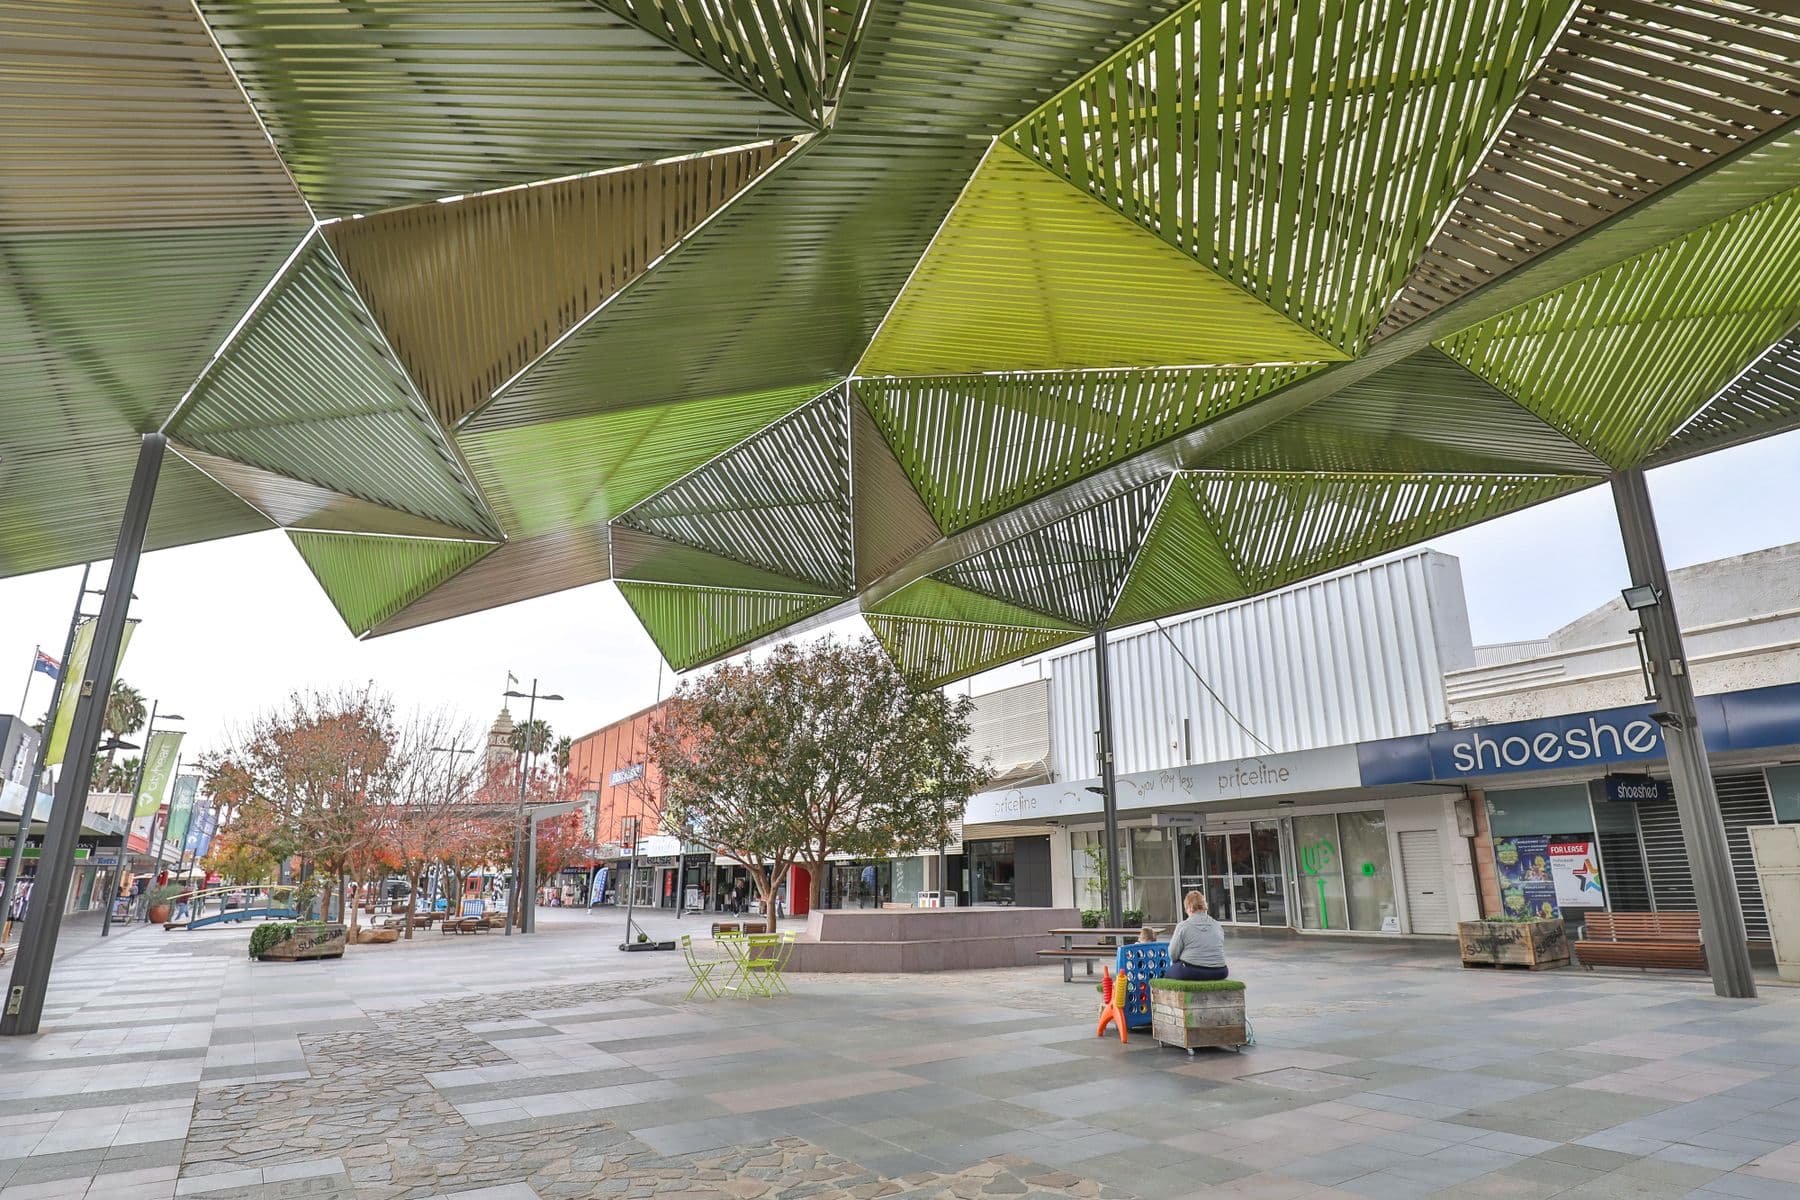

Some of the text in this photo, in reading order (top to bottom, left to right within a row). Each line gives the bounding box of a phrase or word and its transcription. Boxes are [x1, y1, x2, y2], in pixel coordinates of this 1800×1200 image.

[1453, 717, 1666, 772] shoeshe
[1218, 764, 1290, 795] priceline
[1617, 783, 1658, 799] shoeshed
[994, 796, 1037, 817] priceline
[1550, 846, 1563, 854] FOR
[1564, 845, 1585, 853] LEASE
